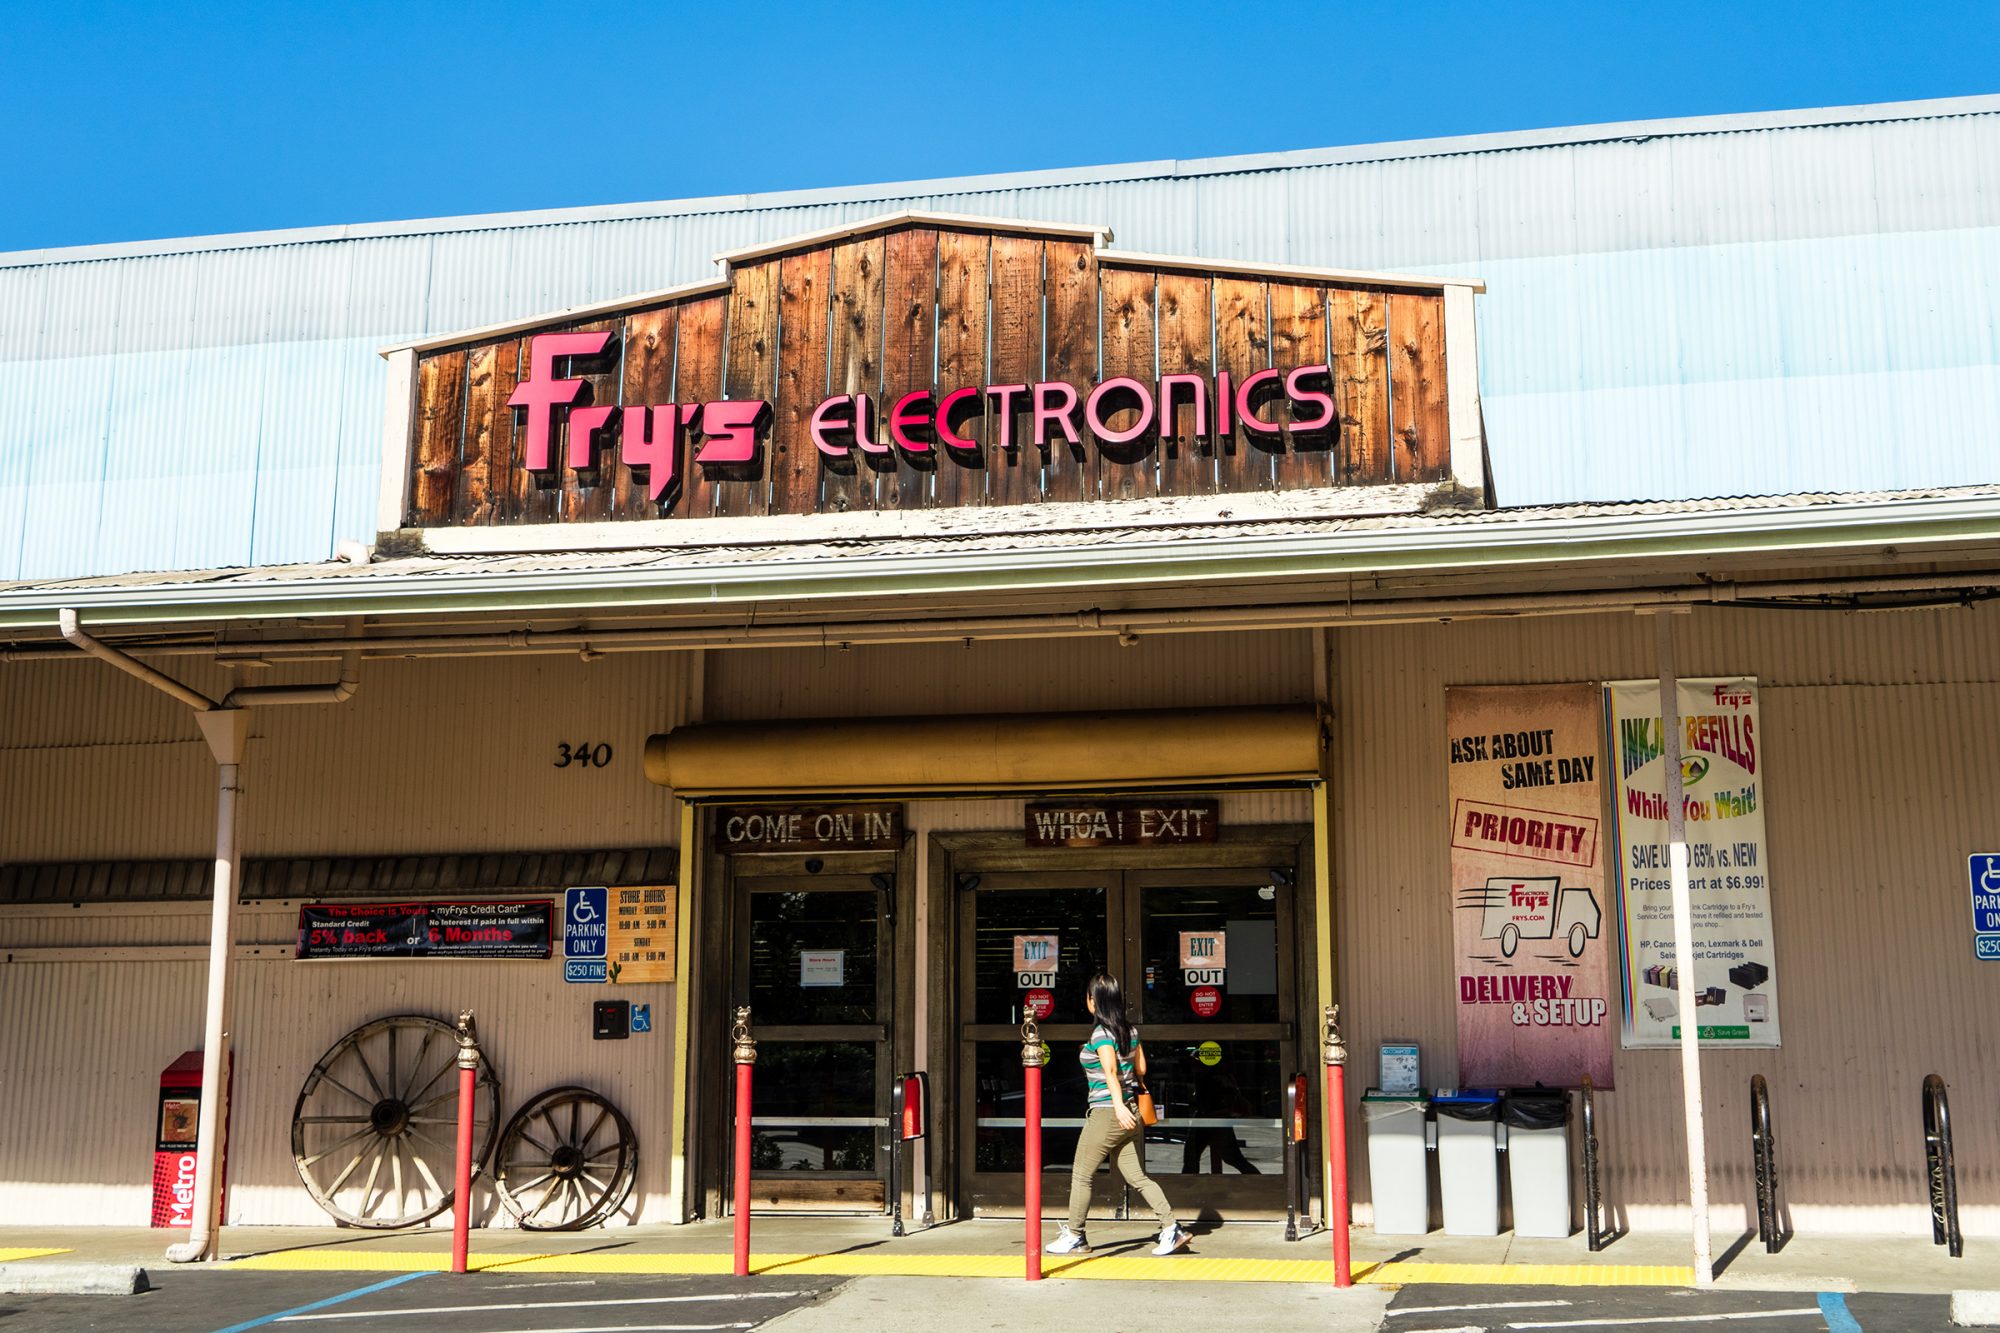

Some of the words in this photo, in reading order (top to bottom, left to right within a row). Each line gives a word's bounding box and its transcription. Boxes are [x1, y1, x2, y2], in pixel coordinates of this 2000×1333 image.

[506, 331, 771, 503] Fry's
[809, 364, 1338, 458] ELECTRONICS
[1713, 685, 1752, 710] Fry's
[1451, 736, 1488, 764] ASK
[1492, 729, 1553, 760] ABOUT
[1685, 713, 1756, 776] REFILLS
[553, 741, 613, 769] 340
[1501, 760, 1555, 790] SAME
[1557, 756, 1594, 784] DAY
[1714, 782, 1757, 820] Wait!
[725, 814, 801, 843] COME
[814, 813, 854, 842] ON
[864, 812, 893, 841] IN
[1034, 810, 1124, 841] WHOA!
[1140, 808, 1209, 838] EXIT
[1464, 810, 1586, 853] PRIORITY
[1632, 845, 1659, 869] SAVE
[1693, 843, 1715, 868] 65%
[1716, 849, 1731, 867] vs.
[1733, 842, 1757, 867] NEW
[1630, 878, 1671, 890] Prices
[1688, 877, 1706, 890] art
[1710, 877, 1723, 889] at
[1726, 875, 1765, 890] $6.99!
[620, 890, 641, 904] STORE
[644, 889, 666, 903] HOURS
[1508, 884, 1549, 912] Fry's
[328, 908, 347, 917] The
[350, 907, 385, 916] Choice
[400, 907, 429, 915] Yours
[437, 905, 468, 916] myFrys
[470, 904, 496, 914] Credit
[1642, 904, 1658, 912] Bring
[1658, 905, 1672, 913] your
[1702, 903, 1729, 912] Cartridge
[1741, 903, 1756, 911] Fry's
[480, 919, 497, 927] paid
[521, 917, 544, 925] within
[566, 923, 605, 937] PARKING
[310, 929, 338, 944] 5%
[343, 929, 388, 944] back
[406, 936, 420, 945] or
[428, 927, 440, 943] 6
[445, 927, 513, 942] Months
[1640, 941, 1652, 949] HP,
[1708, 939, 1740, 948] Lexmark
[1741, 939, 1747, 947] &
[1749, 938, 1763, 947] Dell
[573, 939, 597, 953] ONLY
[1024, 941, 1049, 960] EXIT
[1190, 938, 1216, 957] EXIT
[1660, 951, 1676, 959] Sele
[1705, 950, 1744, 960] Cartridges
[568, 964, 587, 977] $250
[589, 963, 606, 976] FINE
[1186, 970, 1222, 984] OUT
[1020, 973, 1053, 987] OUT
[1460, 975, 1574, 1004] DELIVERY
[1512, 1002, 1531, 1026] &
[1533, 998, 1607, 1026] SETUP
[169, 1155, 196, 1227] Metro
